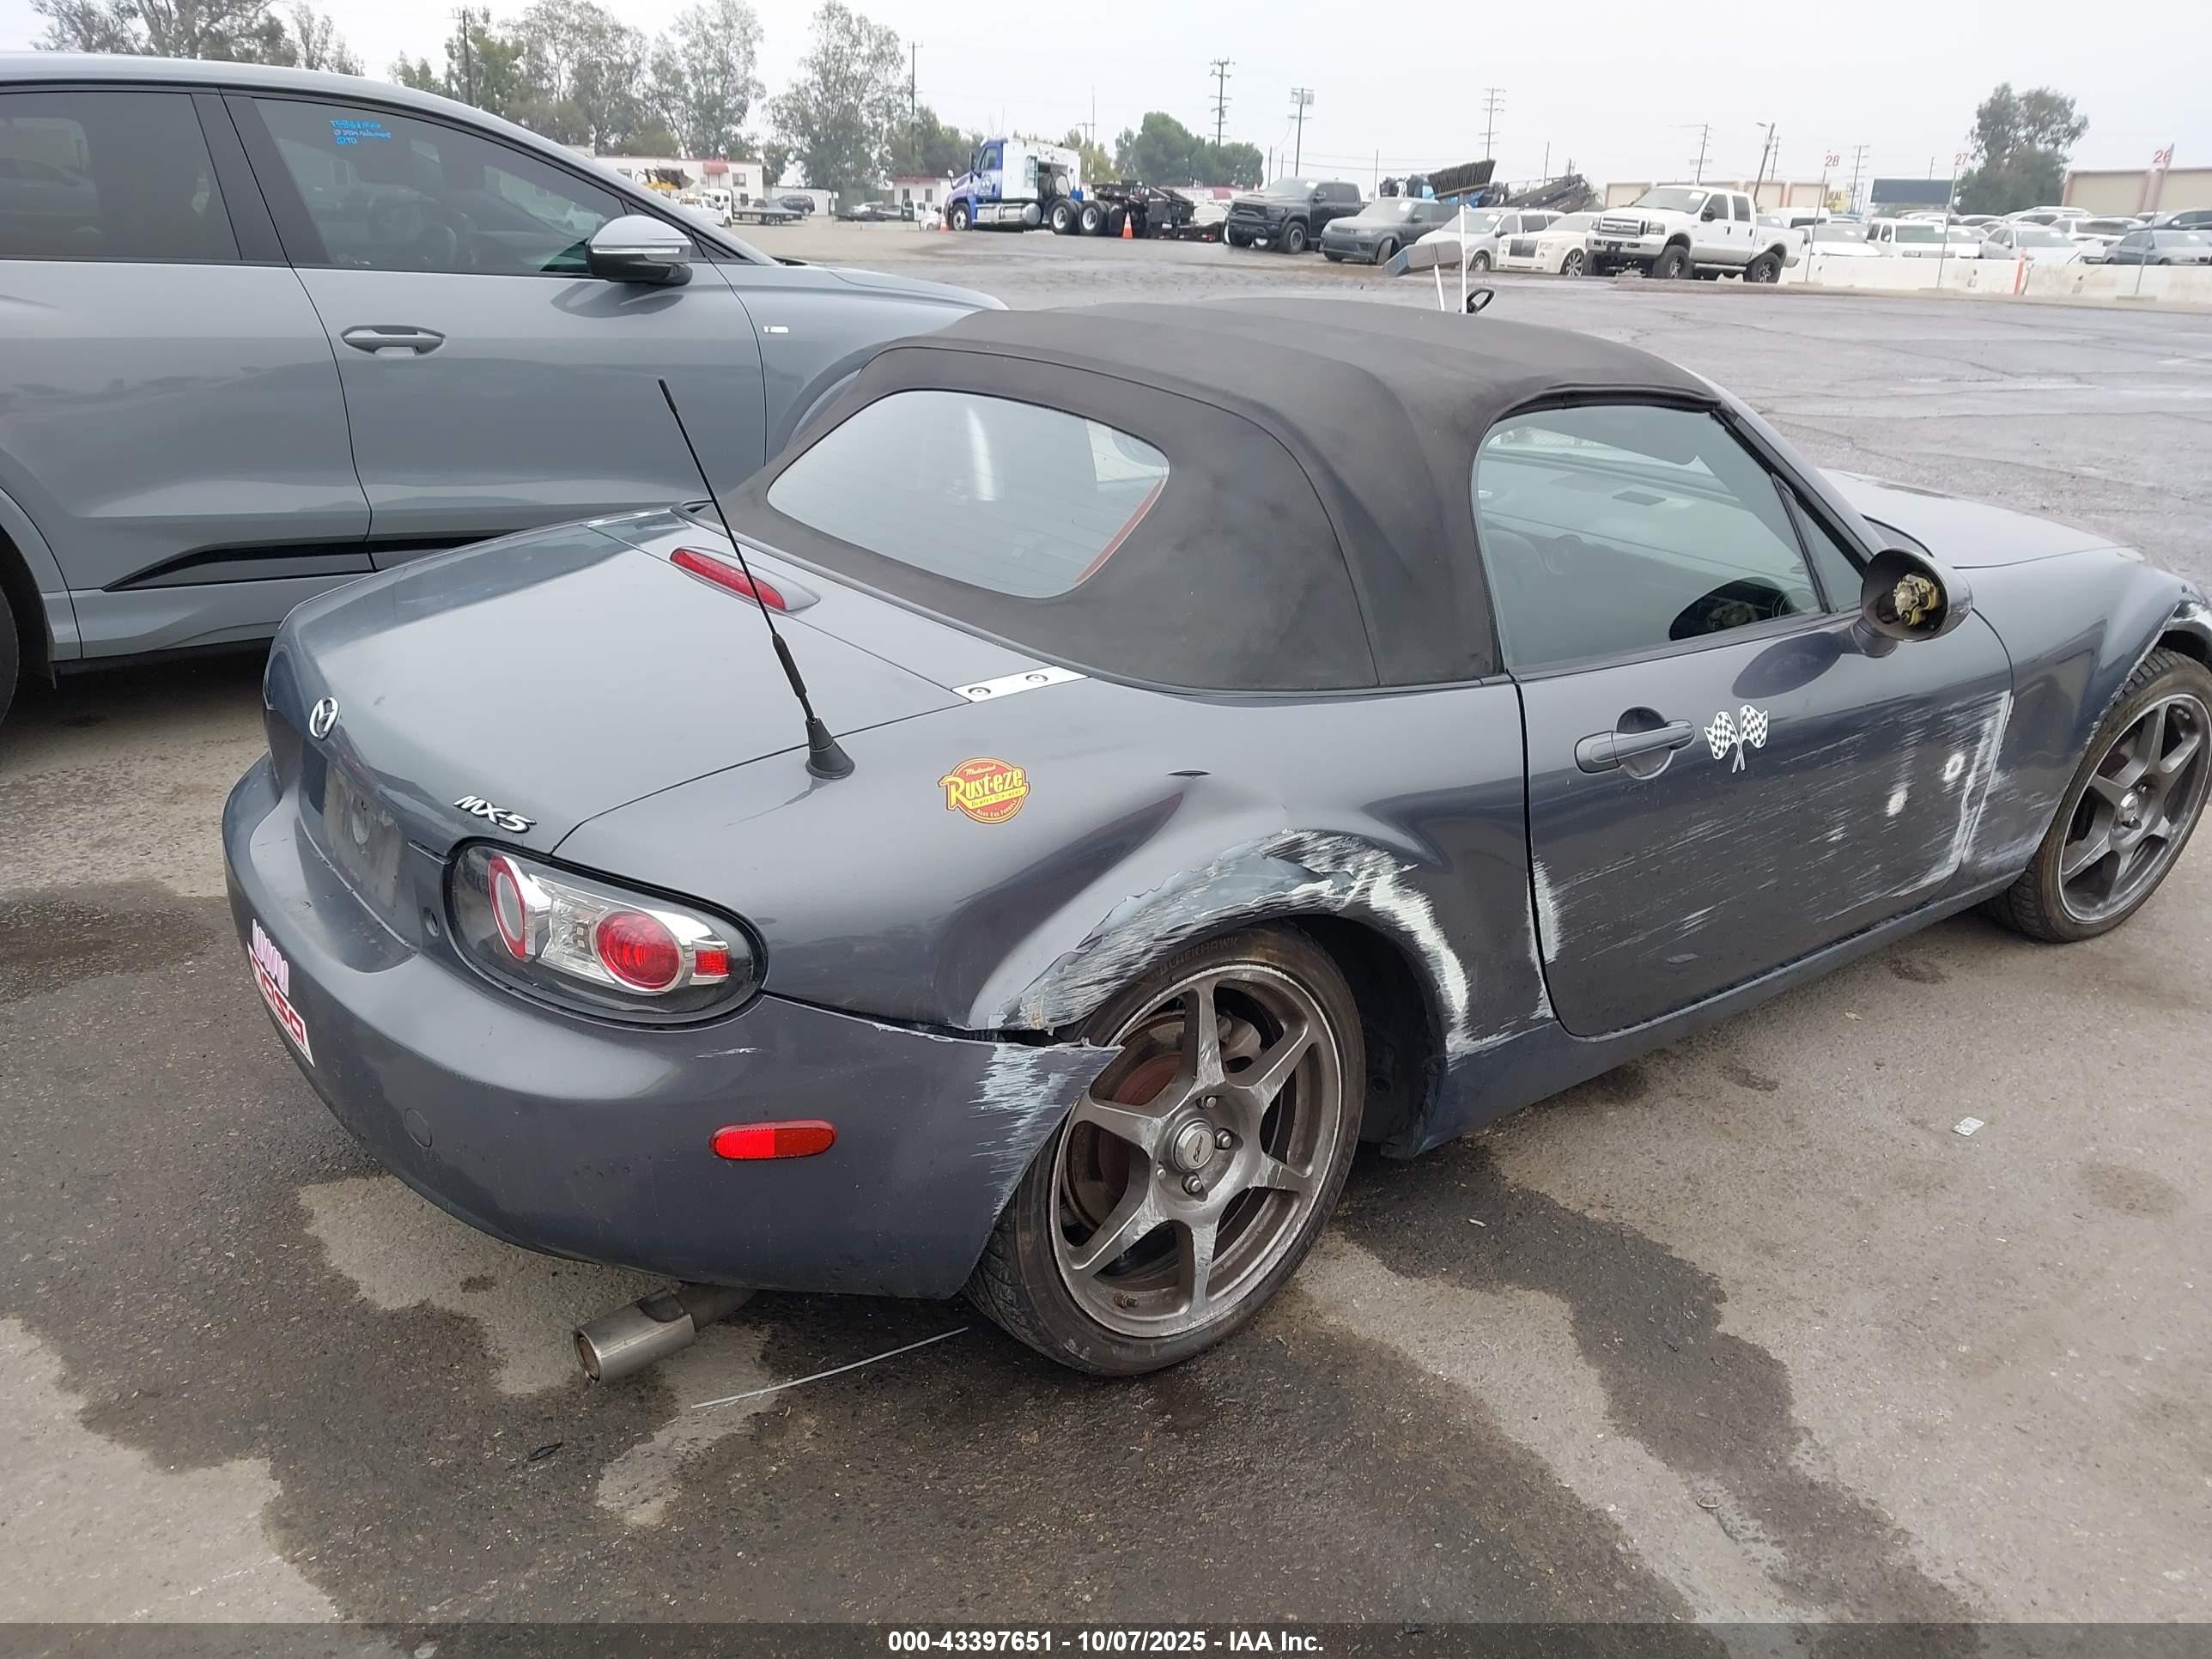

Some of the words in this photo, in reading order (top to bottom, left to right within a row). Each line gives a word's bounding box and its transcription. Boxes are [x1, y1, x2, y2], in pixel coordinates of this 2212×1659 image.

[1825, 155, 1839, 167] 28
[1954, 153, 1969, 165] 27
[453, 795, 537, 833] MX-5
